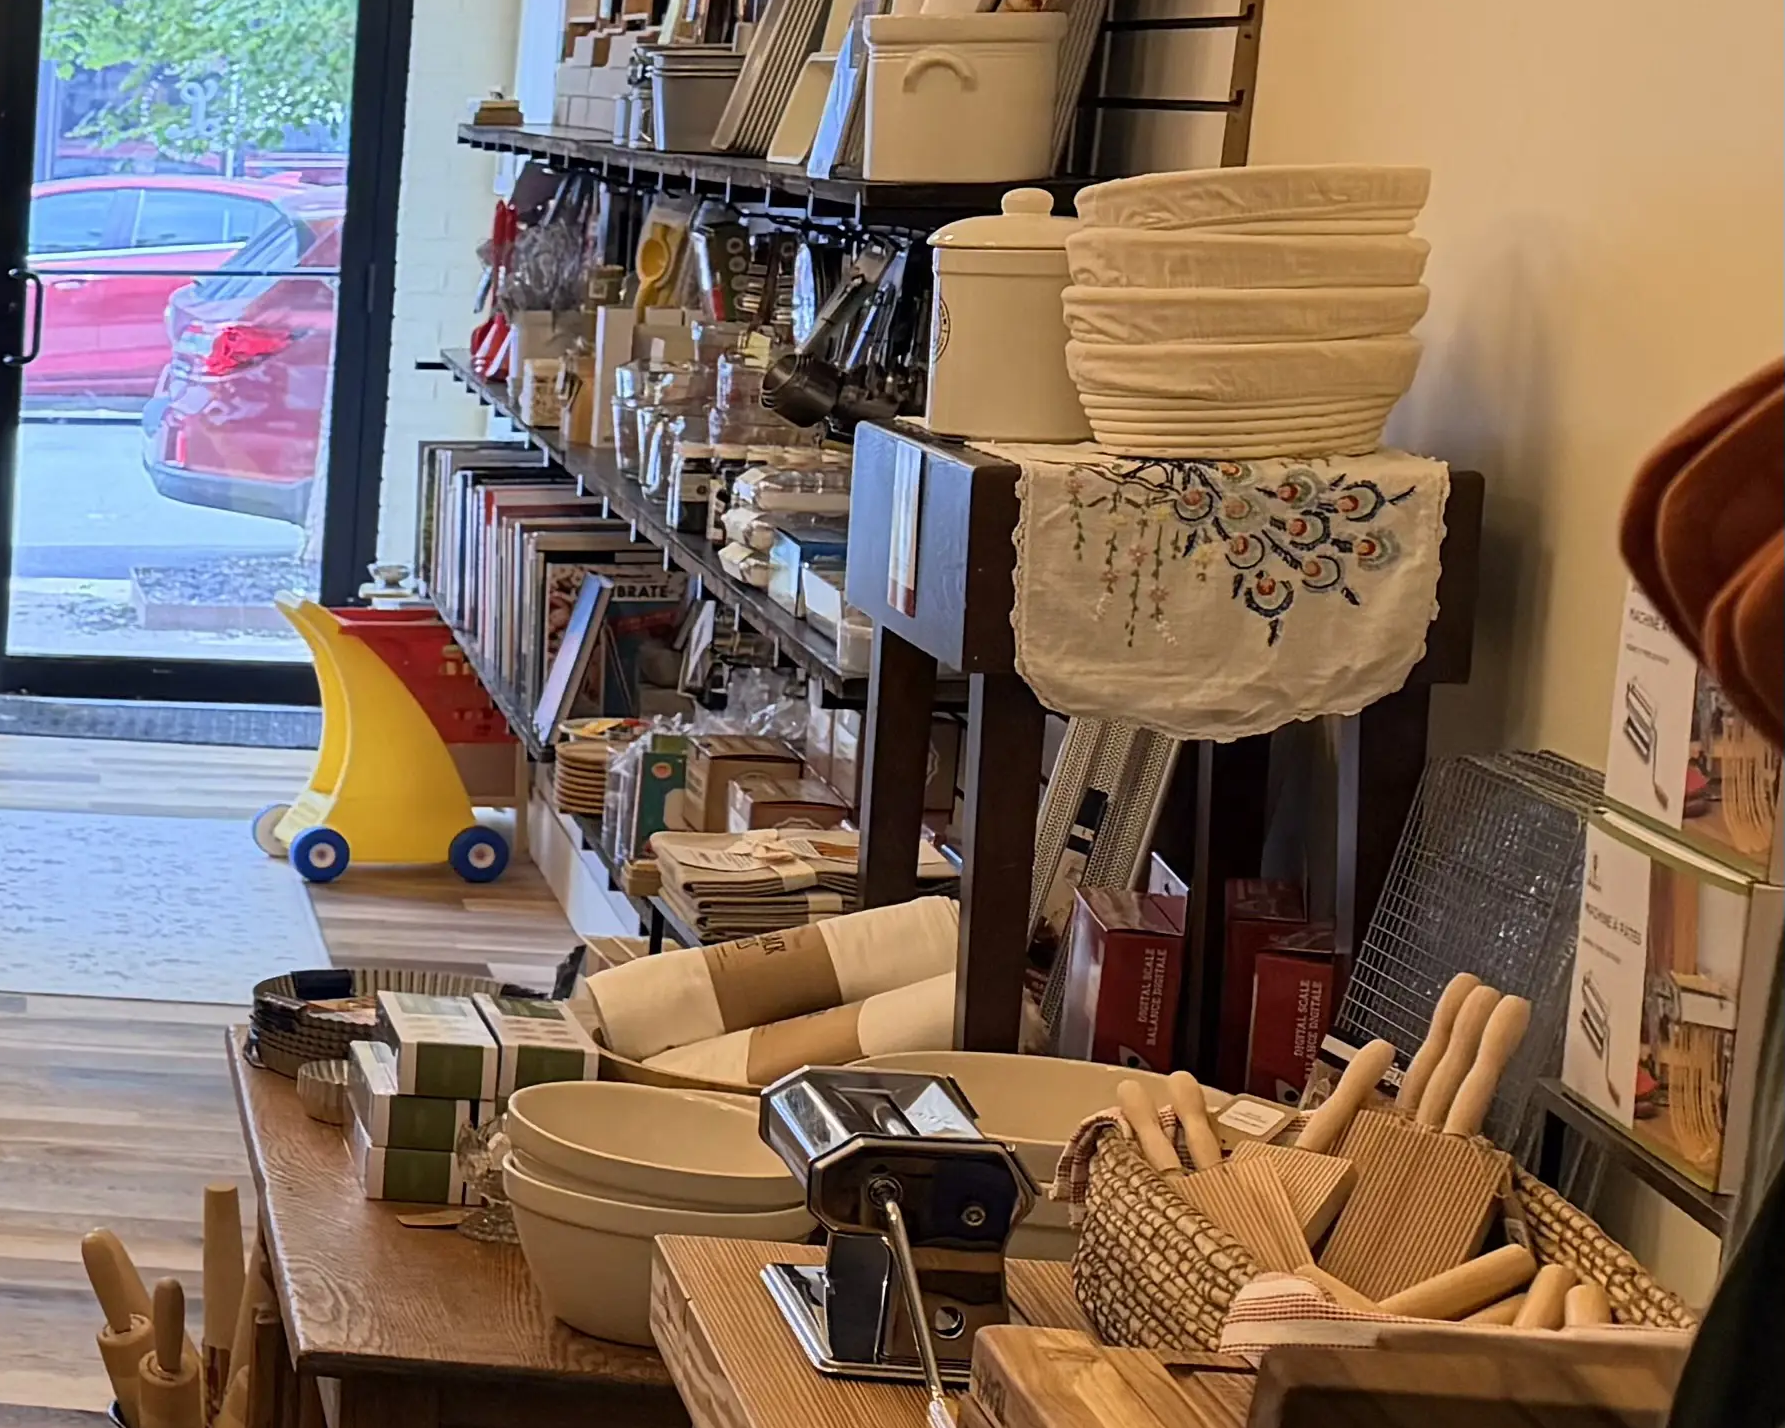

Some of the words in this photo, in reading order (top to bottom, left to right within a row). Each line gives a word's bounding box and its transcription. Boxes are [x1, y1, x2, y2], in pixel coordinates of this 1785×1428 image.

[610, 584, 668, 598] BRATE
[1142, 948, 1156, 978] SCALE
[1153, 948, 1168, 996] DIGITALE
[1137, 979, 1151, 1023] DIGITAL
[1297, 980, 1311, 1013] SCALE
[1309, 980, 1323, 1025] DIGITALE
[1146, 997, 1161, 1047] BALANCE
[1293, 1014, 1307, 1058] DIGITAL
